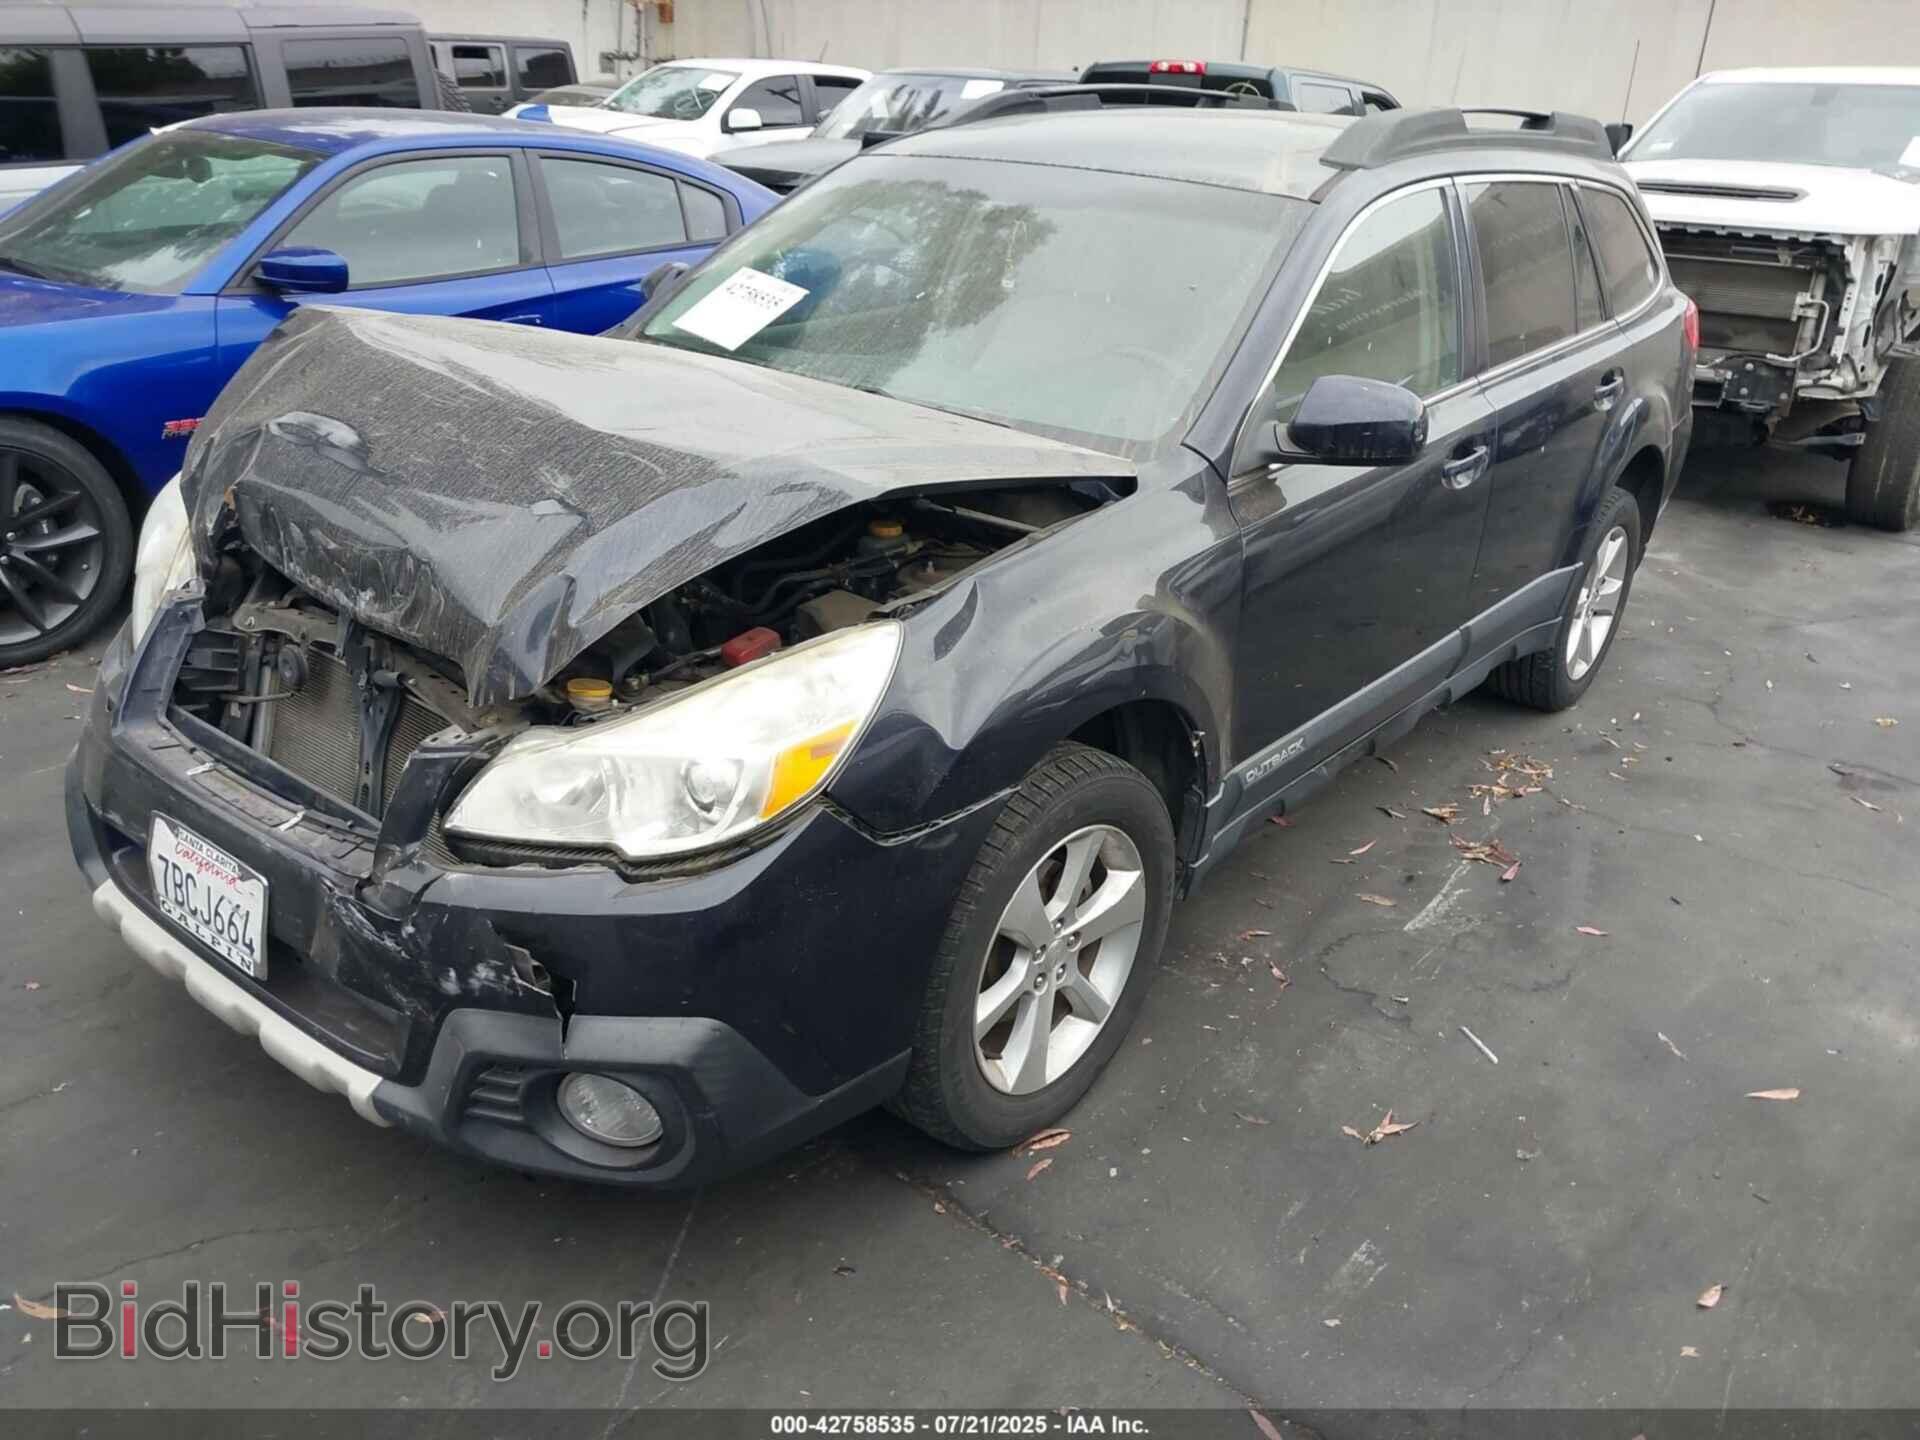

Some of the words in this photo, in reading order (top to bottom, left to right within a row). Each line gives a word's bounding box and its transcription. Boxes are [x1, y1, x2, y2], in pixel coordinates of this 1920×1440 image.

[1246, 737, 1304, 782] OUTBACK
[176, 841, 241, 889] California
[158, 854, 255, 958] 7BCJ664
